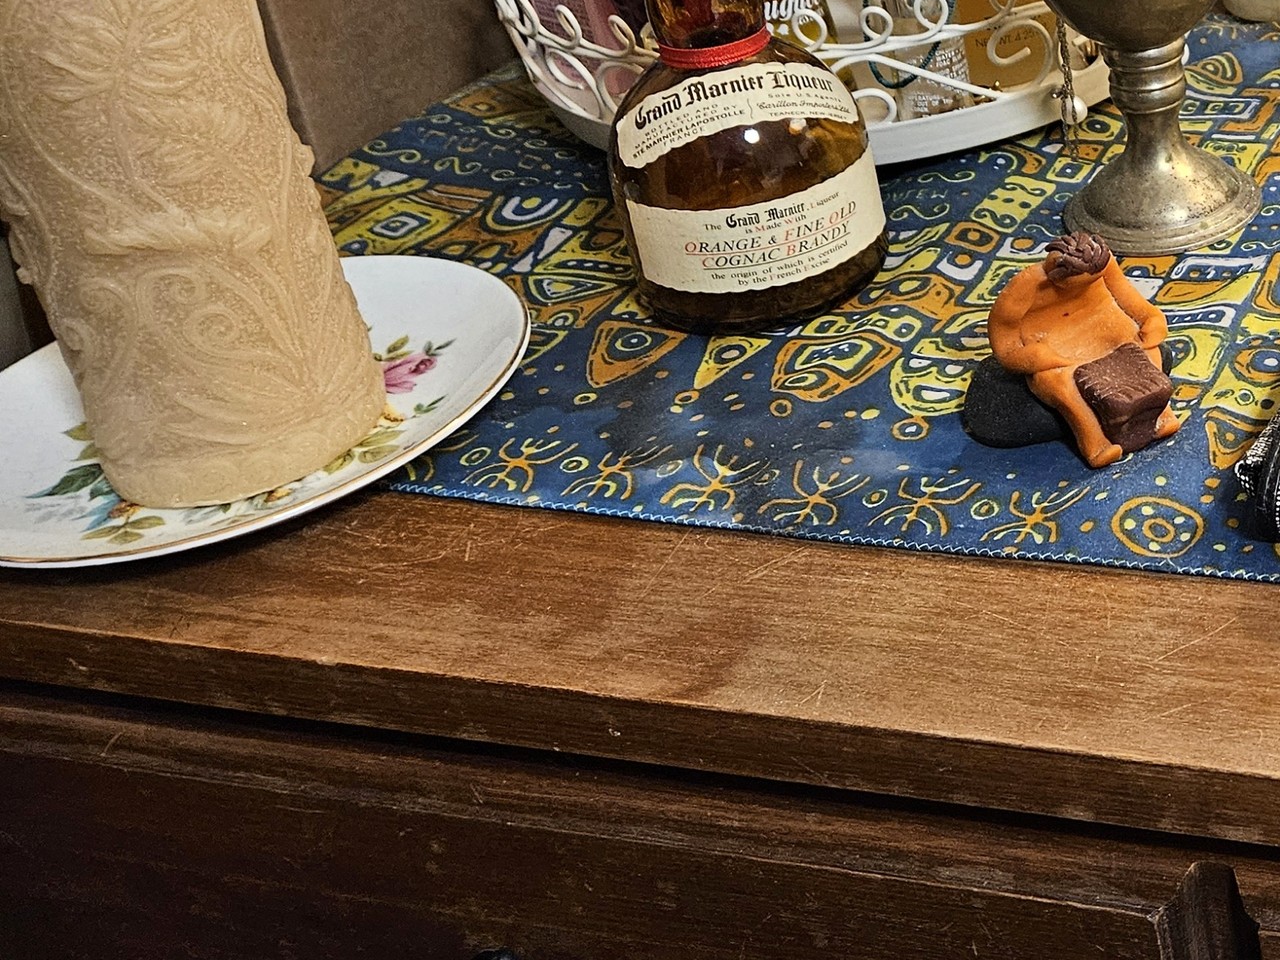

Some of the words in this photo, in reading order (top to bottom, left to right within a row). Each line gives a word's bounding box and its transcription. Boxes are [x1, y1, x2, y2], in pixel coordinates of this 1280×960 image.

[634, 92, 682, 130] Grand
[682, 74, 764, 107] Marnier
[766, 70, 834, 93] Liqueur
[644, 112, 690, 137] BOTTLED
[695, 103, 719, 114] AND
[634, 108, 718, 150] MANUFACTURED
[645, 127, 684, 151] MARNIER
[685, 109, 746, 131] LAPOSTOLLE
[663, 127, 706, 148] FRANCE
[684, 236, 762, 254] ORANGE
[768, 235, 777, 246] &
[784, 217, 825, 242] FINE
[828, 200, 857, 226] OLD
[704, 223, 722, 232] The
[725, 212, 760, 229] Grand
[810, 192, 840, 210] Liqueur
[755, 221, 782, 233] Made
[783, 214, 807, 226] With
[702, 247, 781, 269] COGNAC
[786, 219, 850, 258] BRANDY
[711, 272, 726, 281] the
[730, 270, 758, 281] origin
[762, 266, 773, 276] of
[776, 258, 804, 272] which
[807, 255, 815, 263] is
[818, 239, 849, 259] certified
[738, 278, 750, 287] by
[752, 275, 768, 285] the
[769, 267, 802, 282] French
